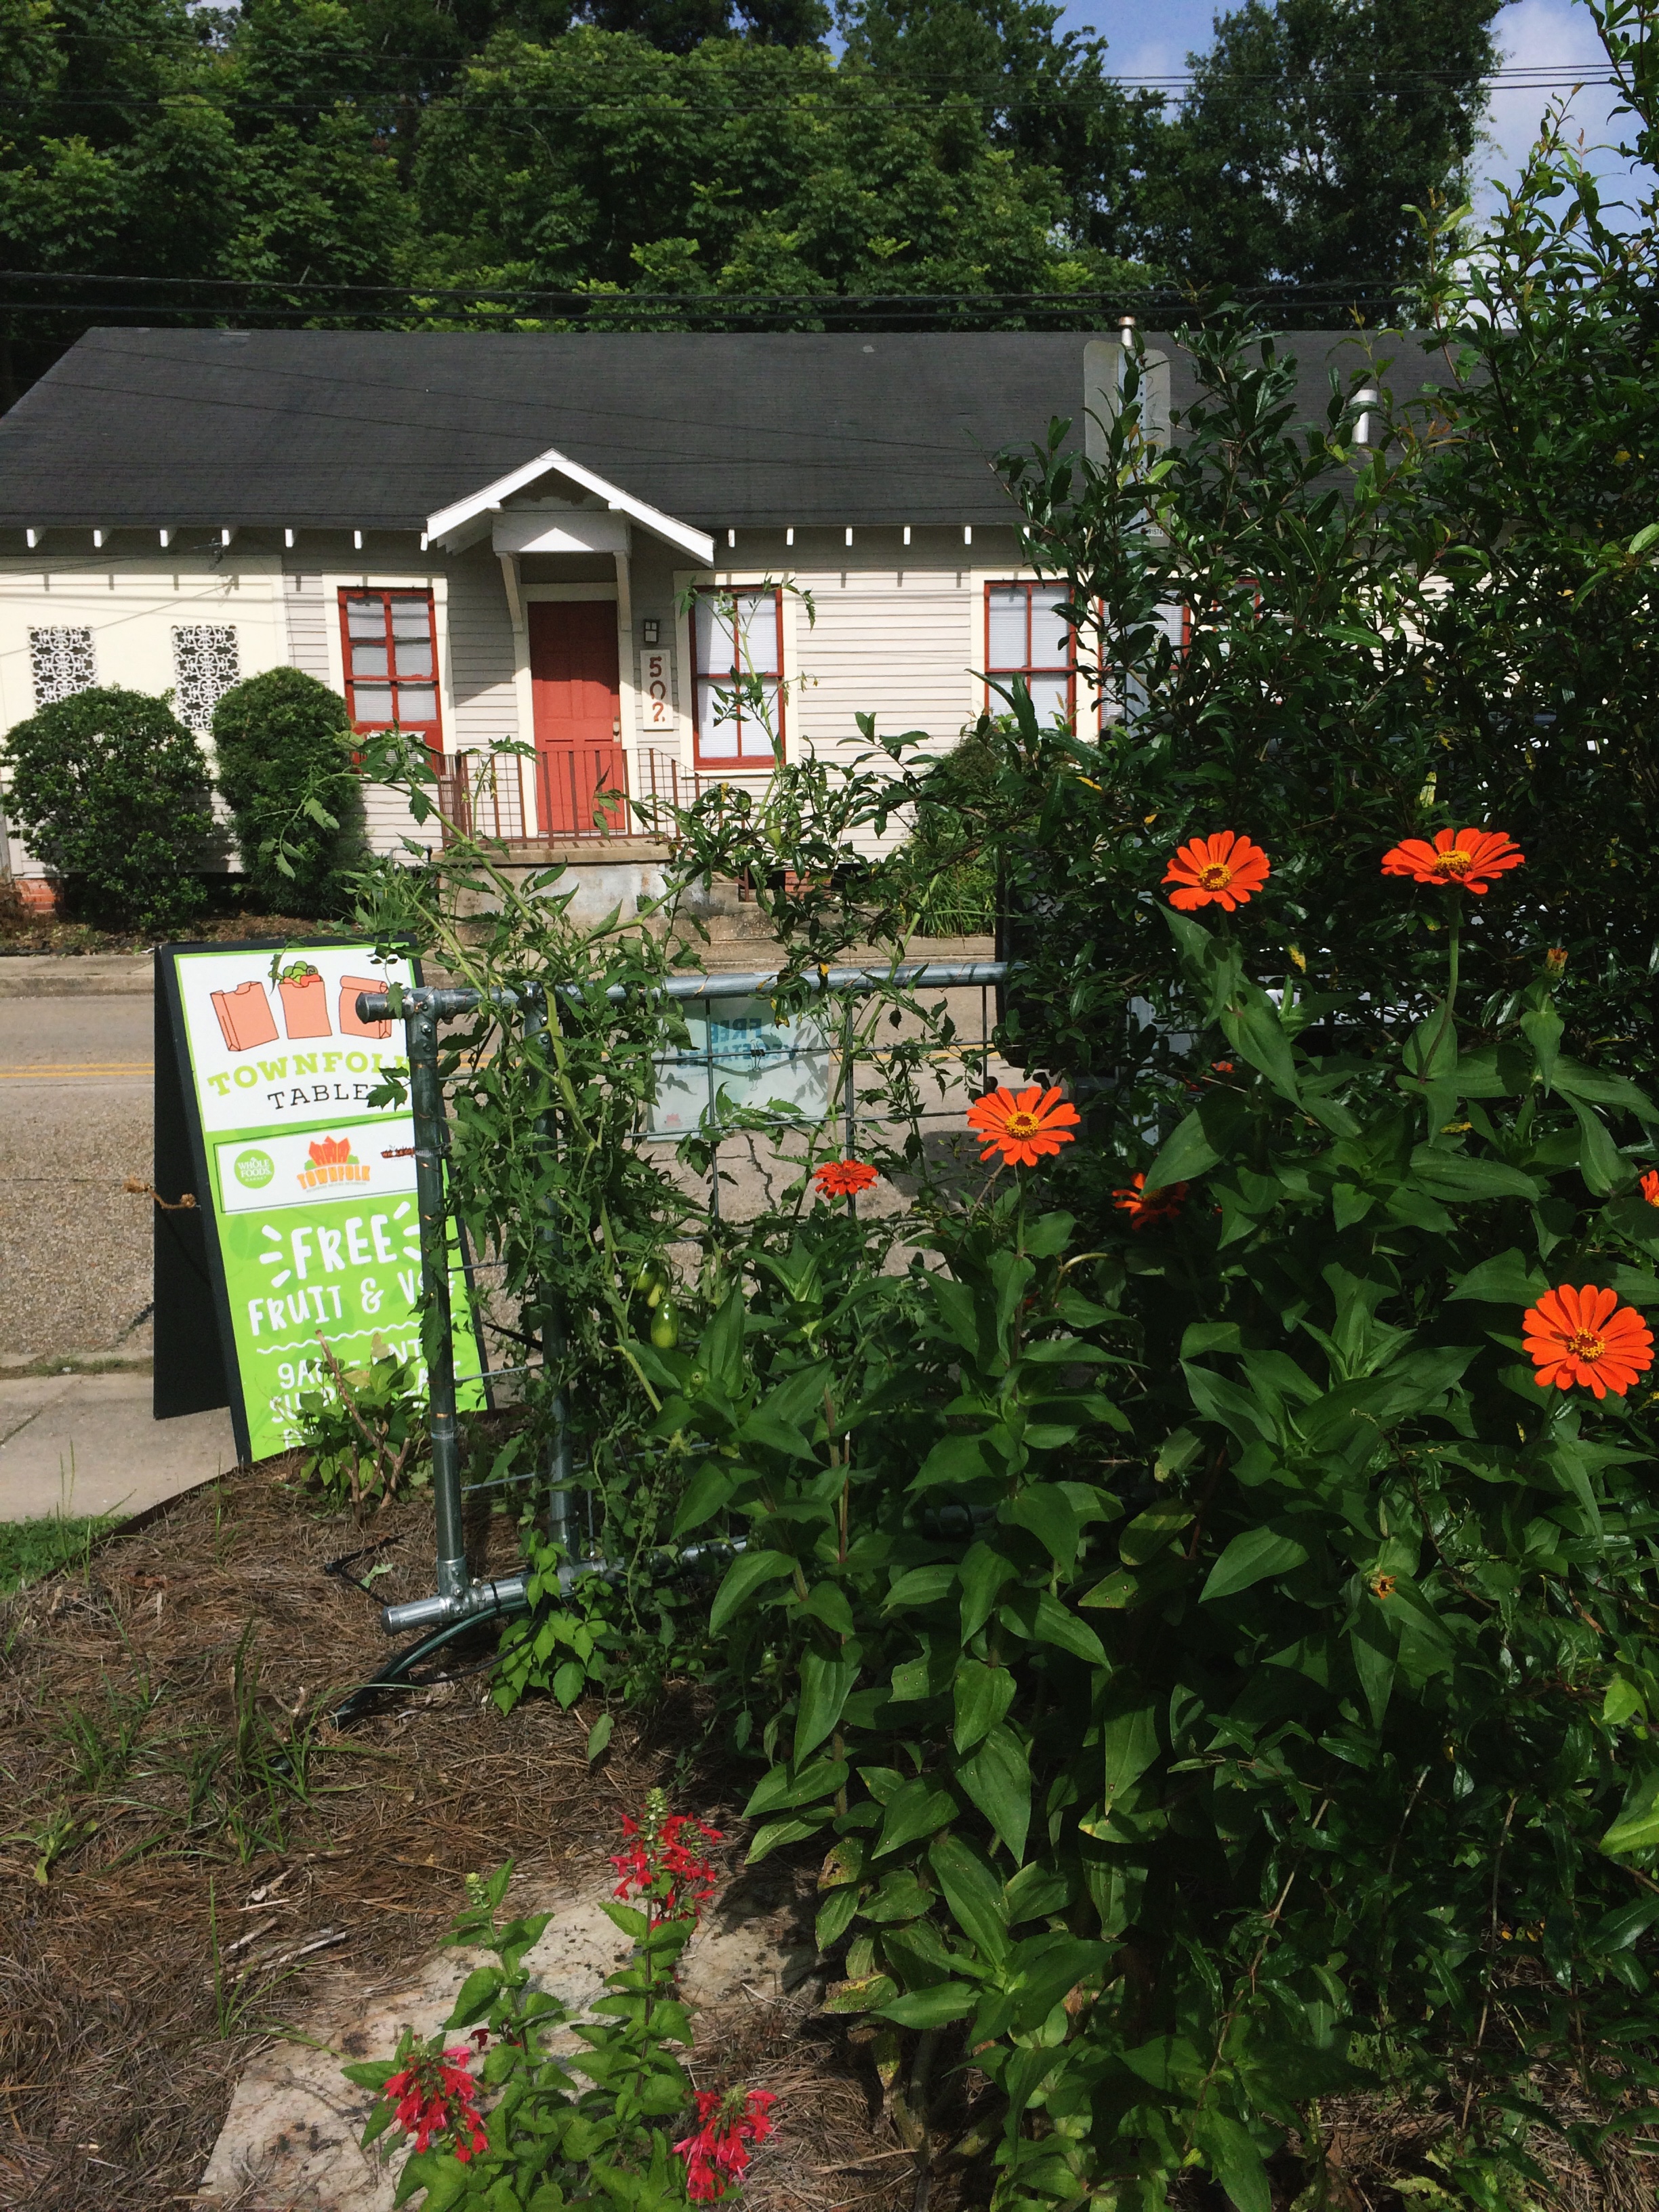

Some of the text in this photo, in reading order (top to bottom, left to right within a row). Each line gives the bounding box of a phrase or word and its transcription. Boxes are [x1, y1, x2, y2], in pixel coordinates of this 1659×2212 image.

[649, 655, 666, 722] 502
[267, 1084, 370, 1109] TABLE
[296, 1165, 370, 1189] TOWNFOLK
[291, 1214, 397, 1279] FREE
[248, 1285, 342, 1336] FRUIT
[360, 1277, 384, 1313] &
